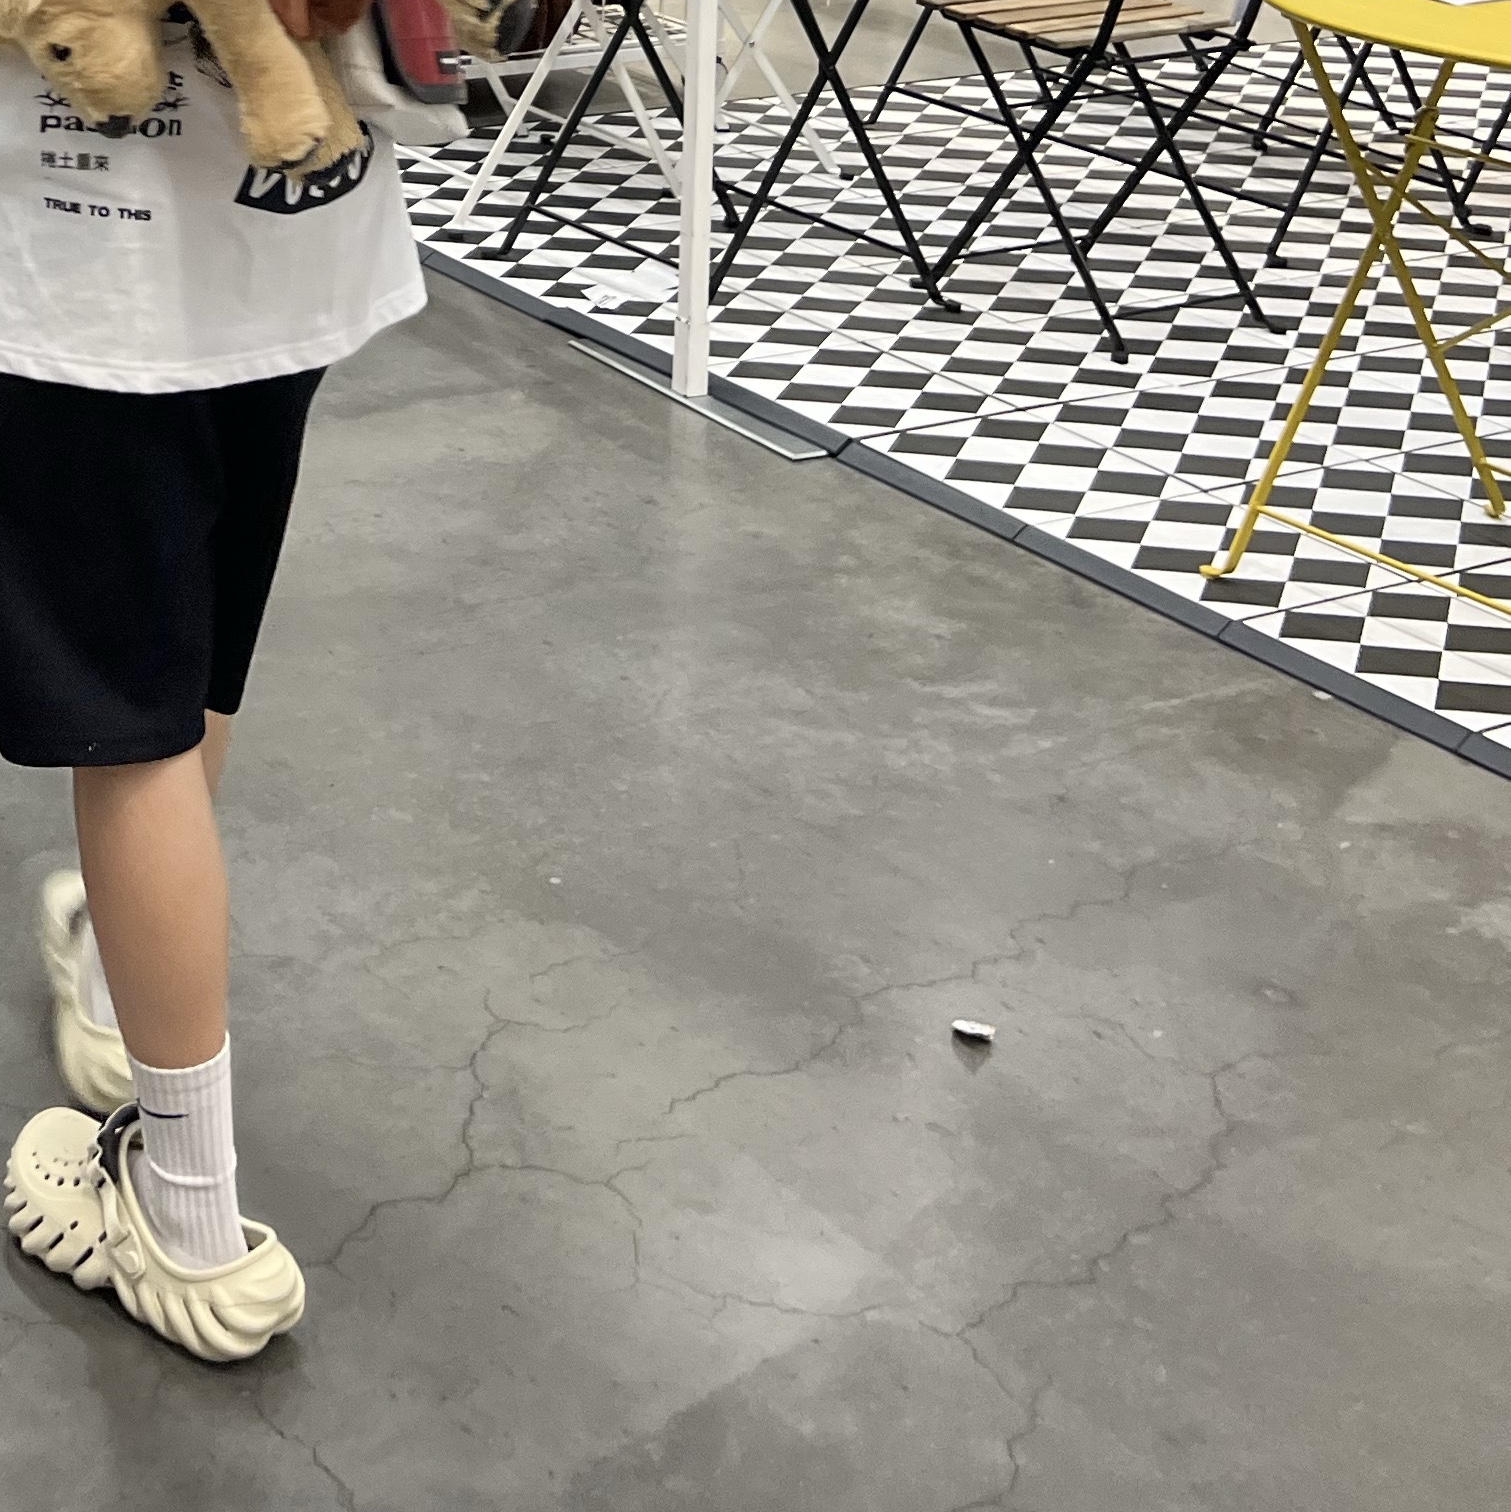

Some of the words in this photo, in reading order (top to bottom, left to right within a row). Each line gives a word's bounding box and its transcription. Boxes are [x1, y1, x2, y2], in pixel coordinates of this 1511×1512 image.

[44, 197, 82, 215] TRUE
[87, 204, 110, 218] TO
[117, 207, 152, 221] THIS
